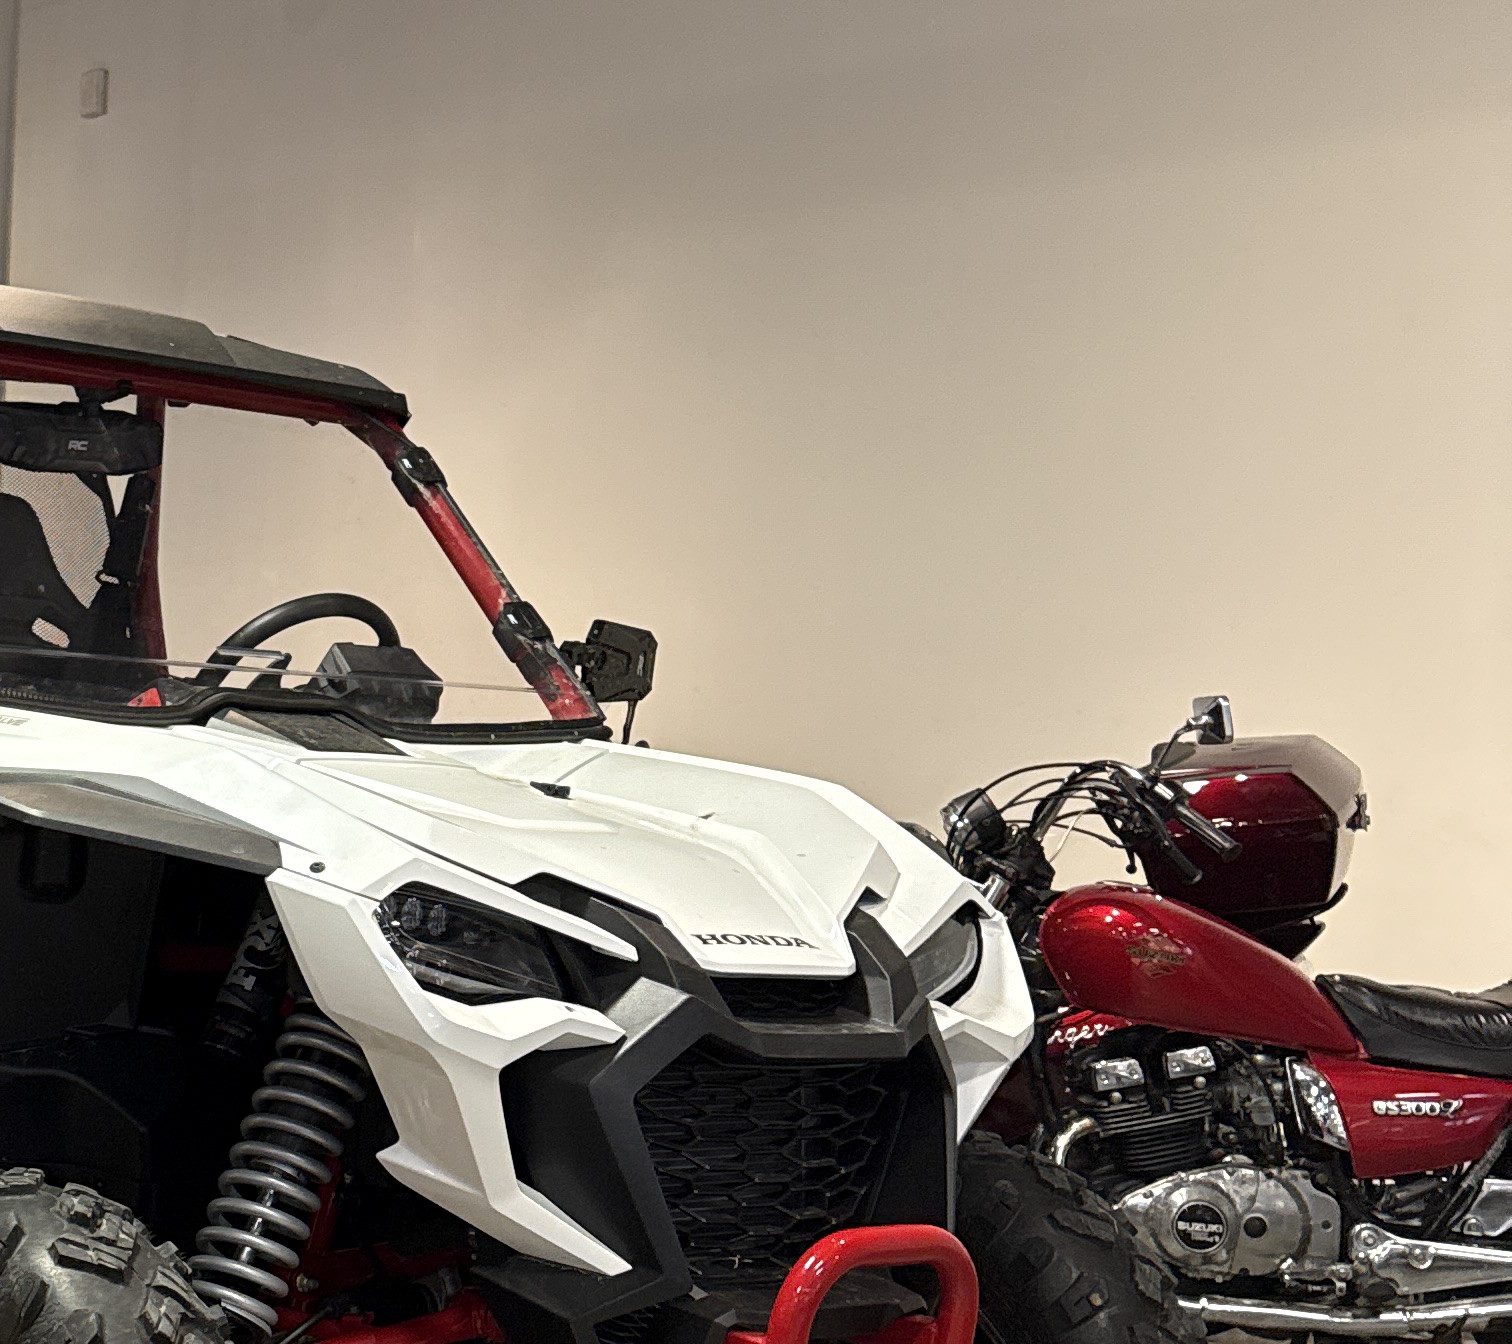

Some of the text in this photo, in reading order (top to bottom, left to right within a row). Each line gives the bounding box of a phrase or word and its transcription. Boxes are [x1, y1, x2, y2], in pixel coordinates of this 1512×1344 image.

[68, 440, 89, 452] RC
[690, 933, 822, 950] HONDA
[1177, 1220, 1224, 1233] SUZUKI
